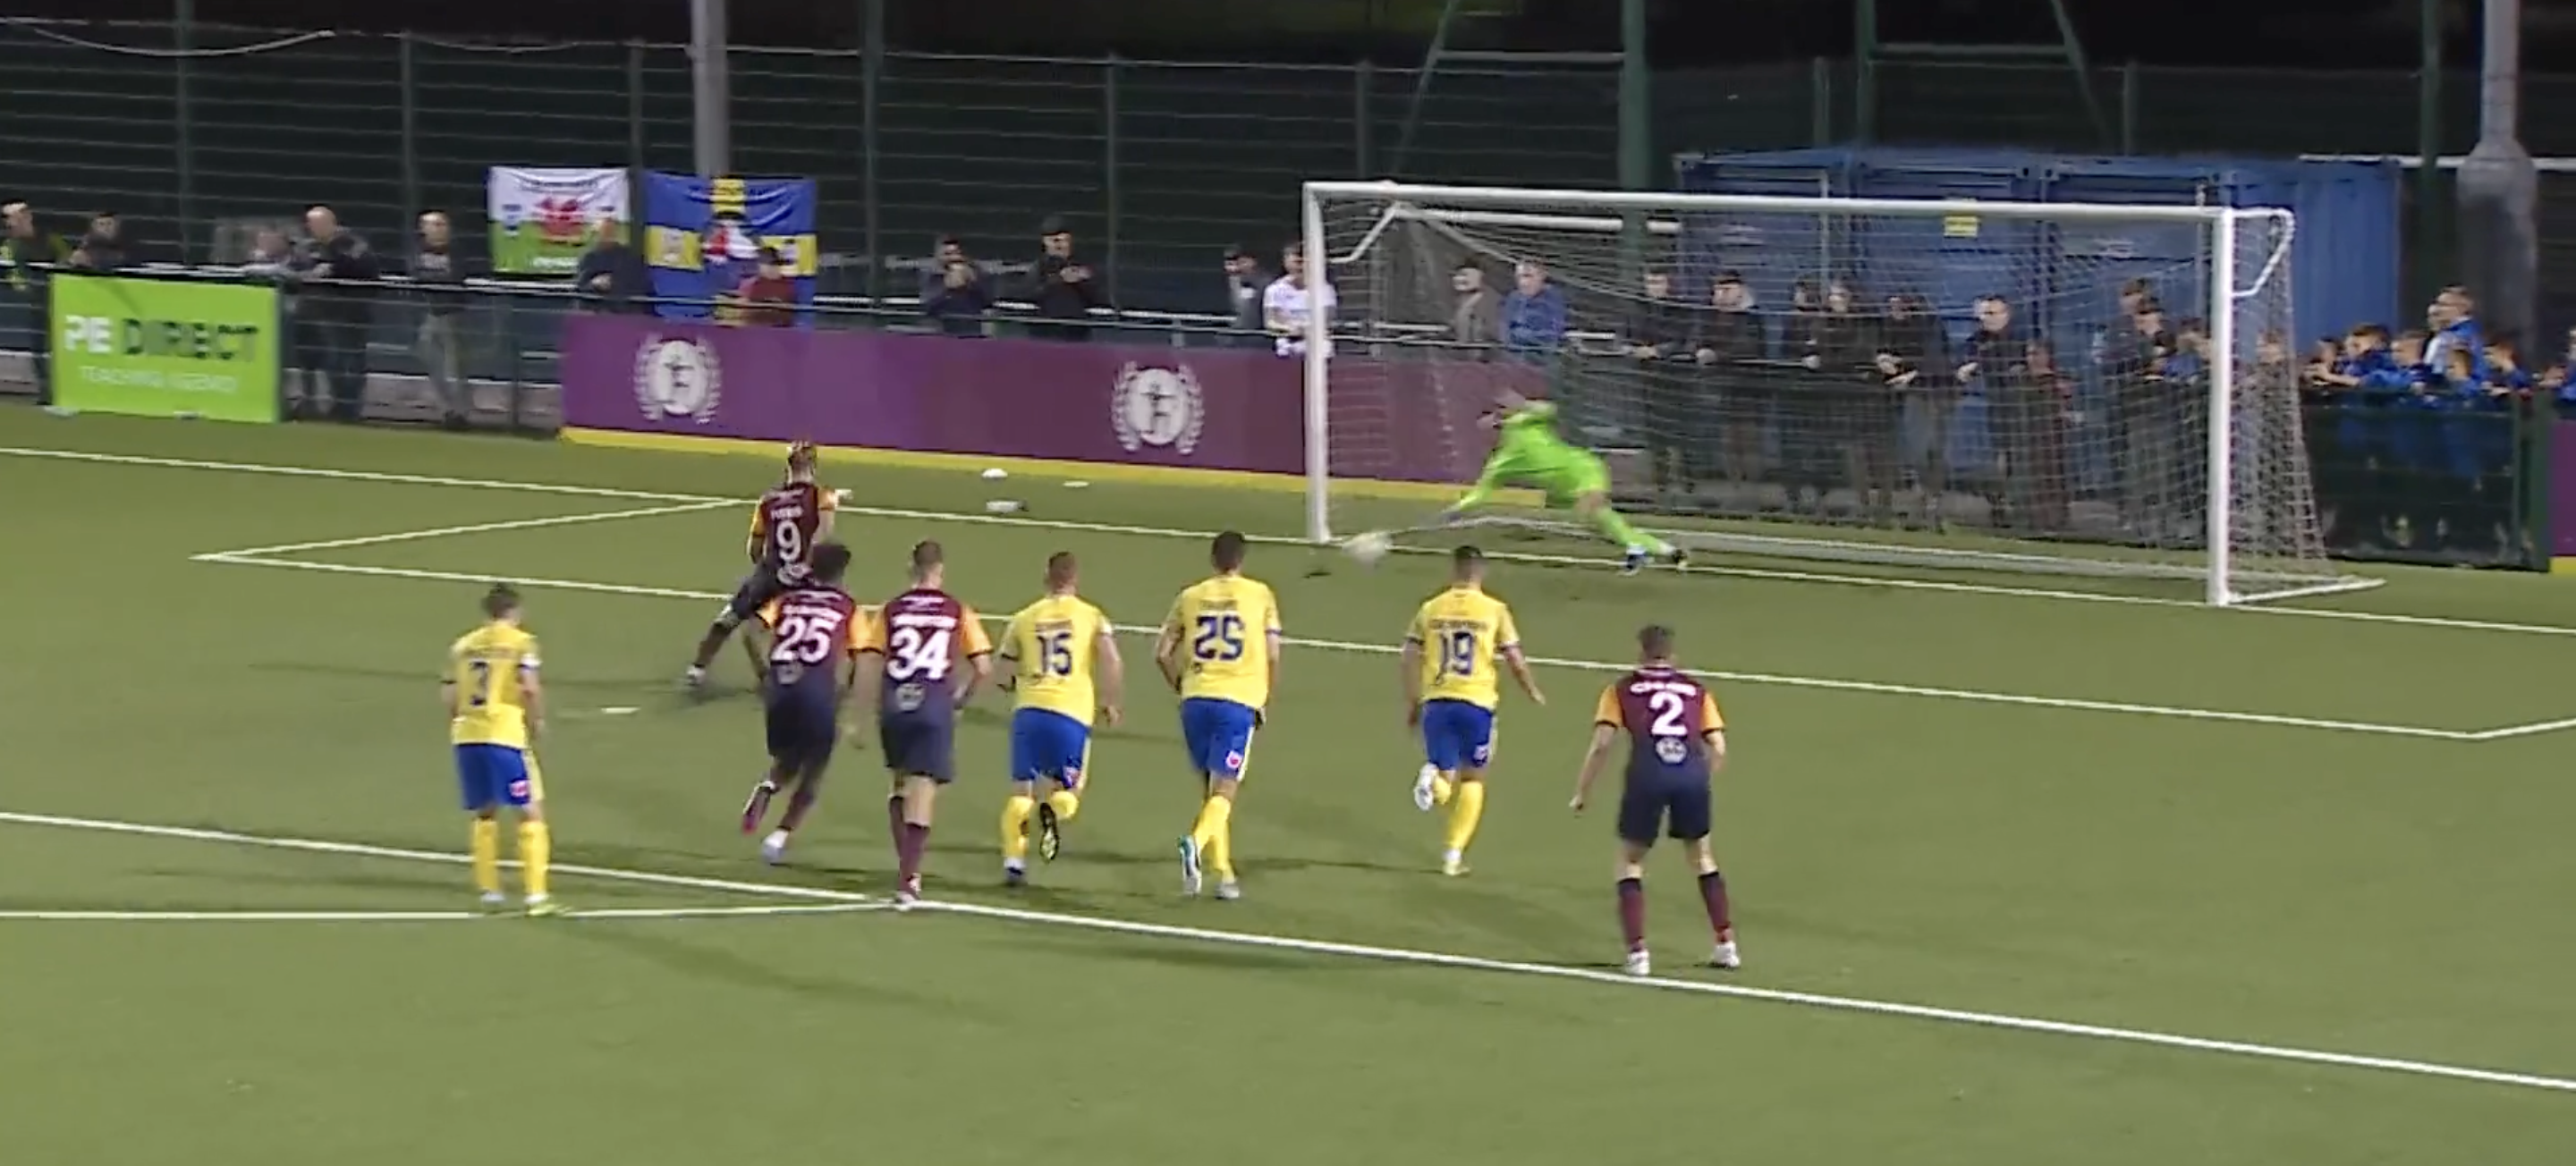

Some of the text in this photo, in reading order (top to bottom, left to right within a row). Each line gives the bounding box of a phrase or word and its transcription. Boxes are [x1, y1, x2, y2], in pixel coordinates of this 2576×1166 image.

[64, 315, 259, 362] PE DIRECT
[776, 520, 801, 562] 9
[771, 617, 835, 663] 25
[887, 627, 951, 680] 34
[1036, 631, 1073, 675] 15
[1194, 614, 1244, 660] 25
[1440, 631, 1474, 675] 19
[1649, 690, 1688, 734] 2
